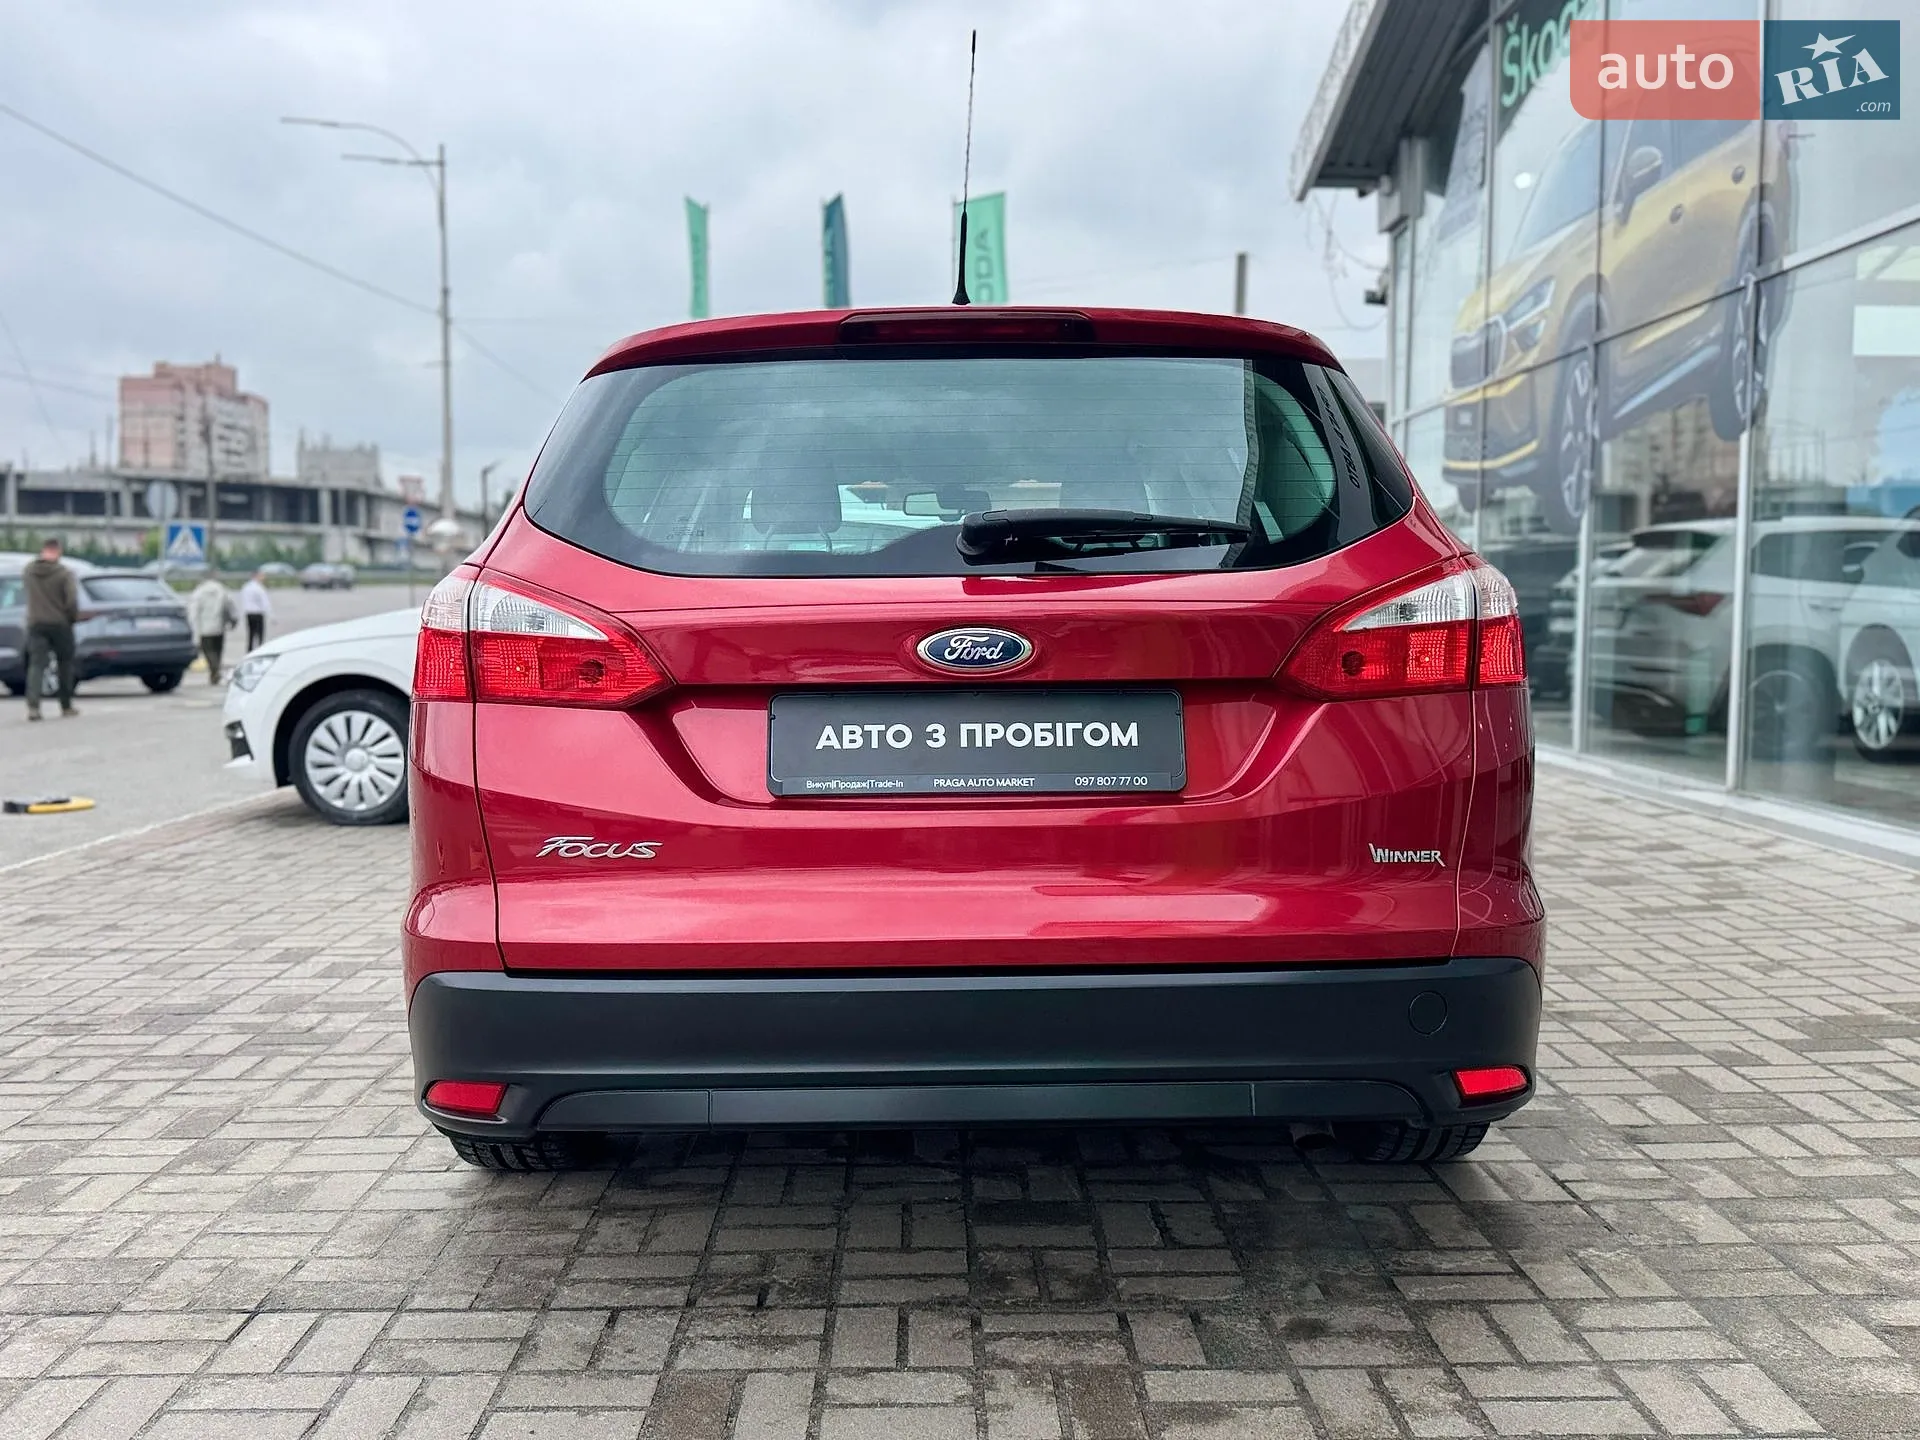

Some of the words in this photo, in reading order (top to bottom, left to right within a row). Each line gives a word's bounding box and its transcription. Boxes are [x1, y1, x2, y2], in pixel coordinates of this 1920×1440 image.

[944, 635, 1004, 660] Ford
[815, 724, 913, 749] АВТО
[960, 722, 1139, 748] ПРОБІГОМ
[933, 778, 966, 787] PRAGA
[967, 778, 995, 787] AUTO
[996, 777, 1035, 787] MARKET
[1074, 777, 1094, 786] 097
[1096, 777, 1116, 786] 807
[1118, 776, 1132, 786] 77
[1133, 776, 1148, 786] 00
